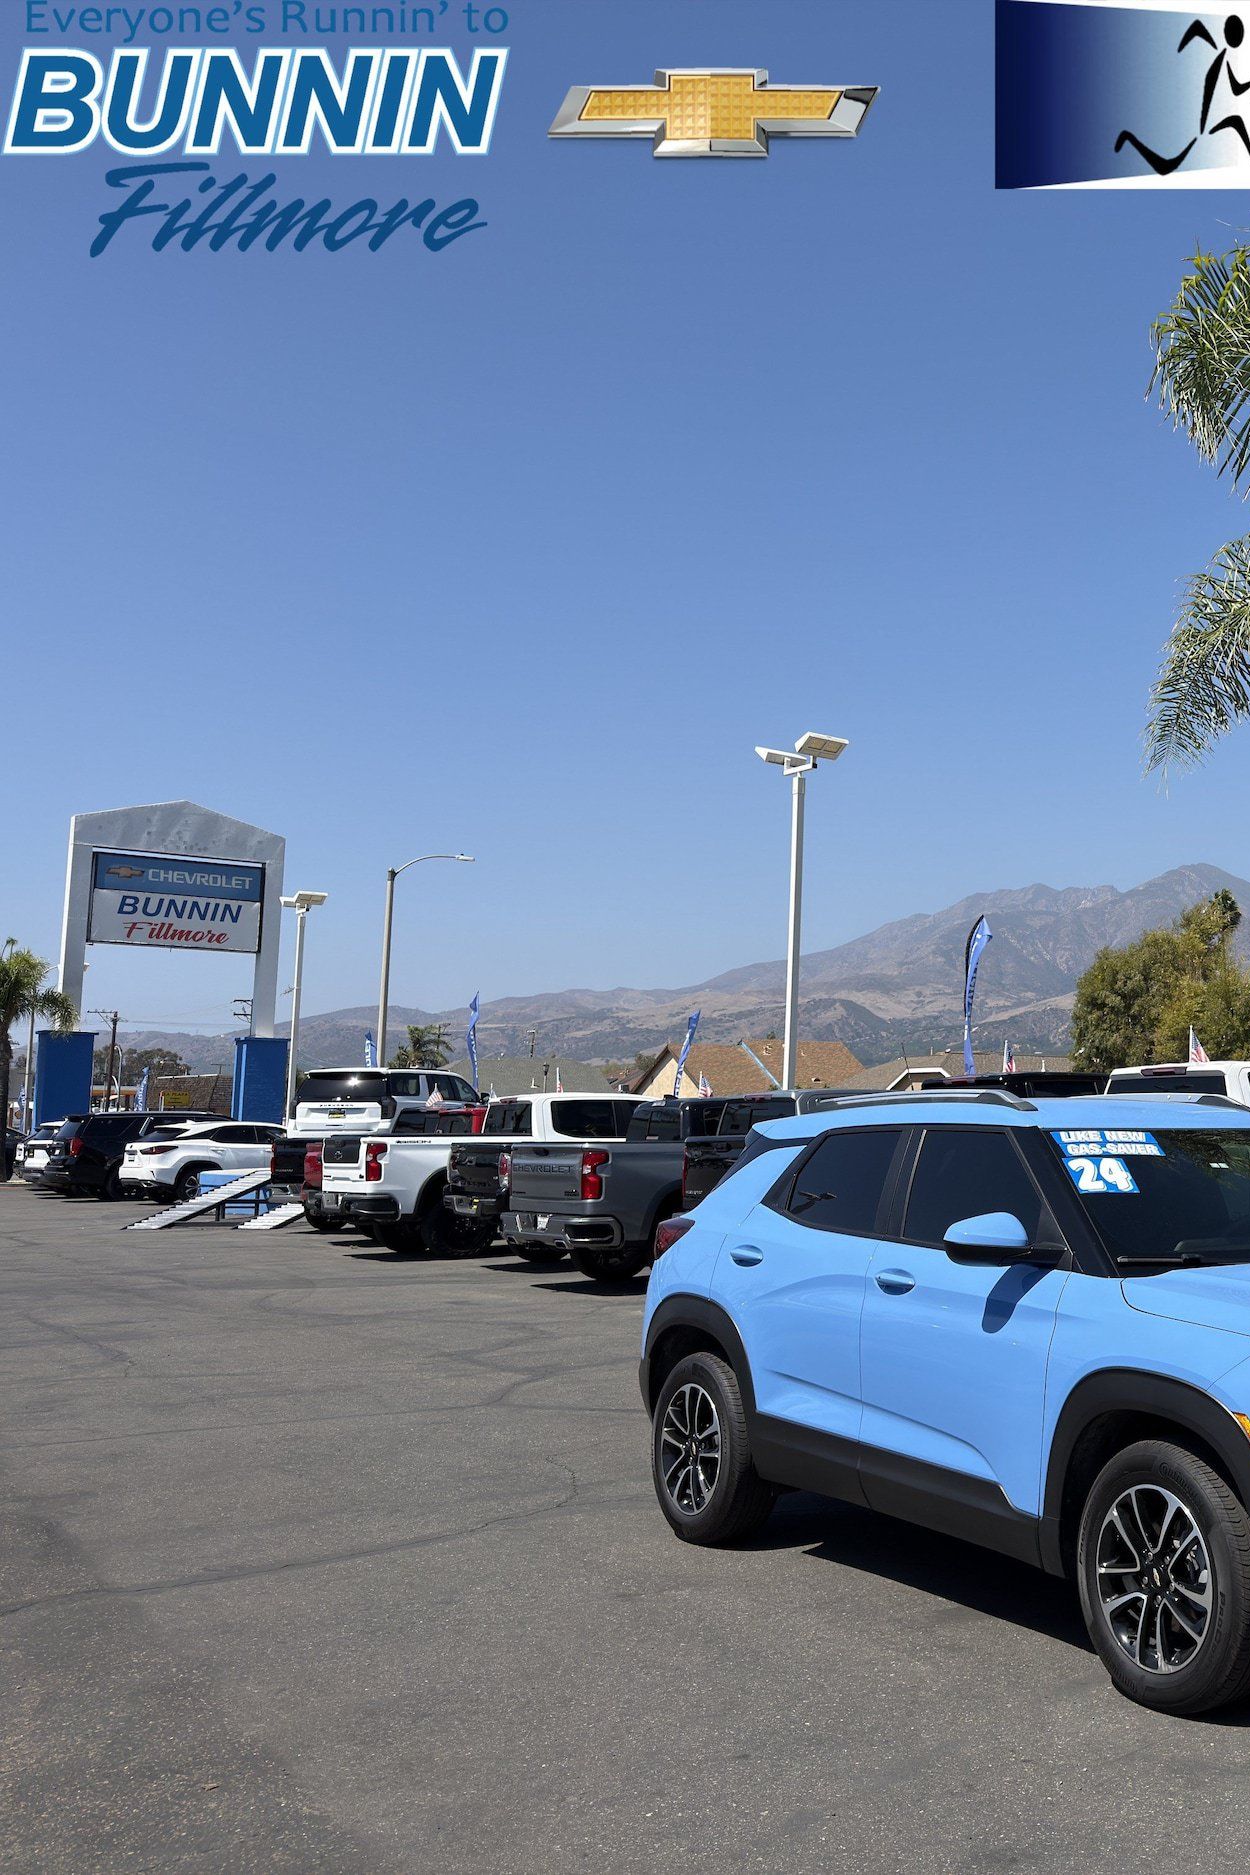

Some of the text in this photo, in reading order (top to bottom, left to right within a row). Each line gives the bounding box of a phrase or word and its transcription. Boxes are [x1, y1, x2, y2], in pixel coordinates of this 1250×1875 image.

[148, 868, 253, 890] CHEVROLET
[117, 895, 242, 923] BUNNIN
[123, 921, 230, 945] Fillmore
[1060, 1131, 1146, 1142] LIKE NEW
[1066, 1143, 1161, 1156] GAS-SAVER
[512, 1165, 574, 1173] CHEVROLET
[1067, 1158, 1134, 1191] 24
